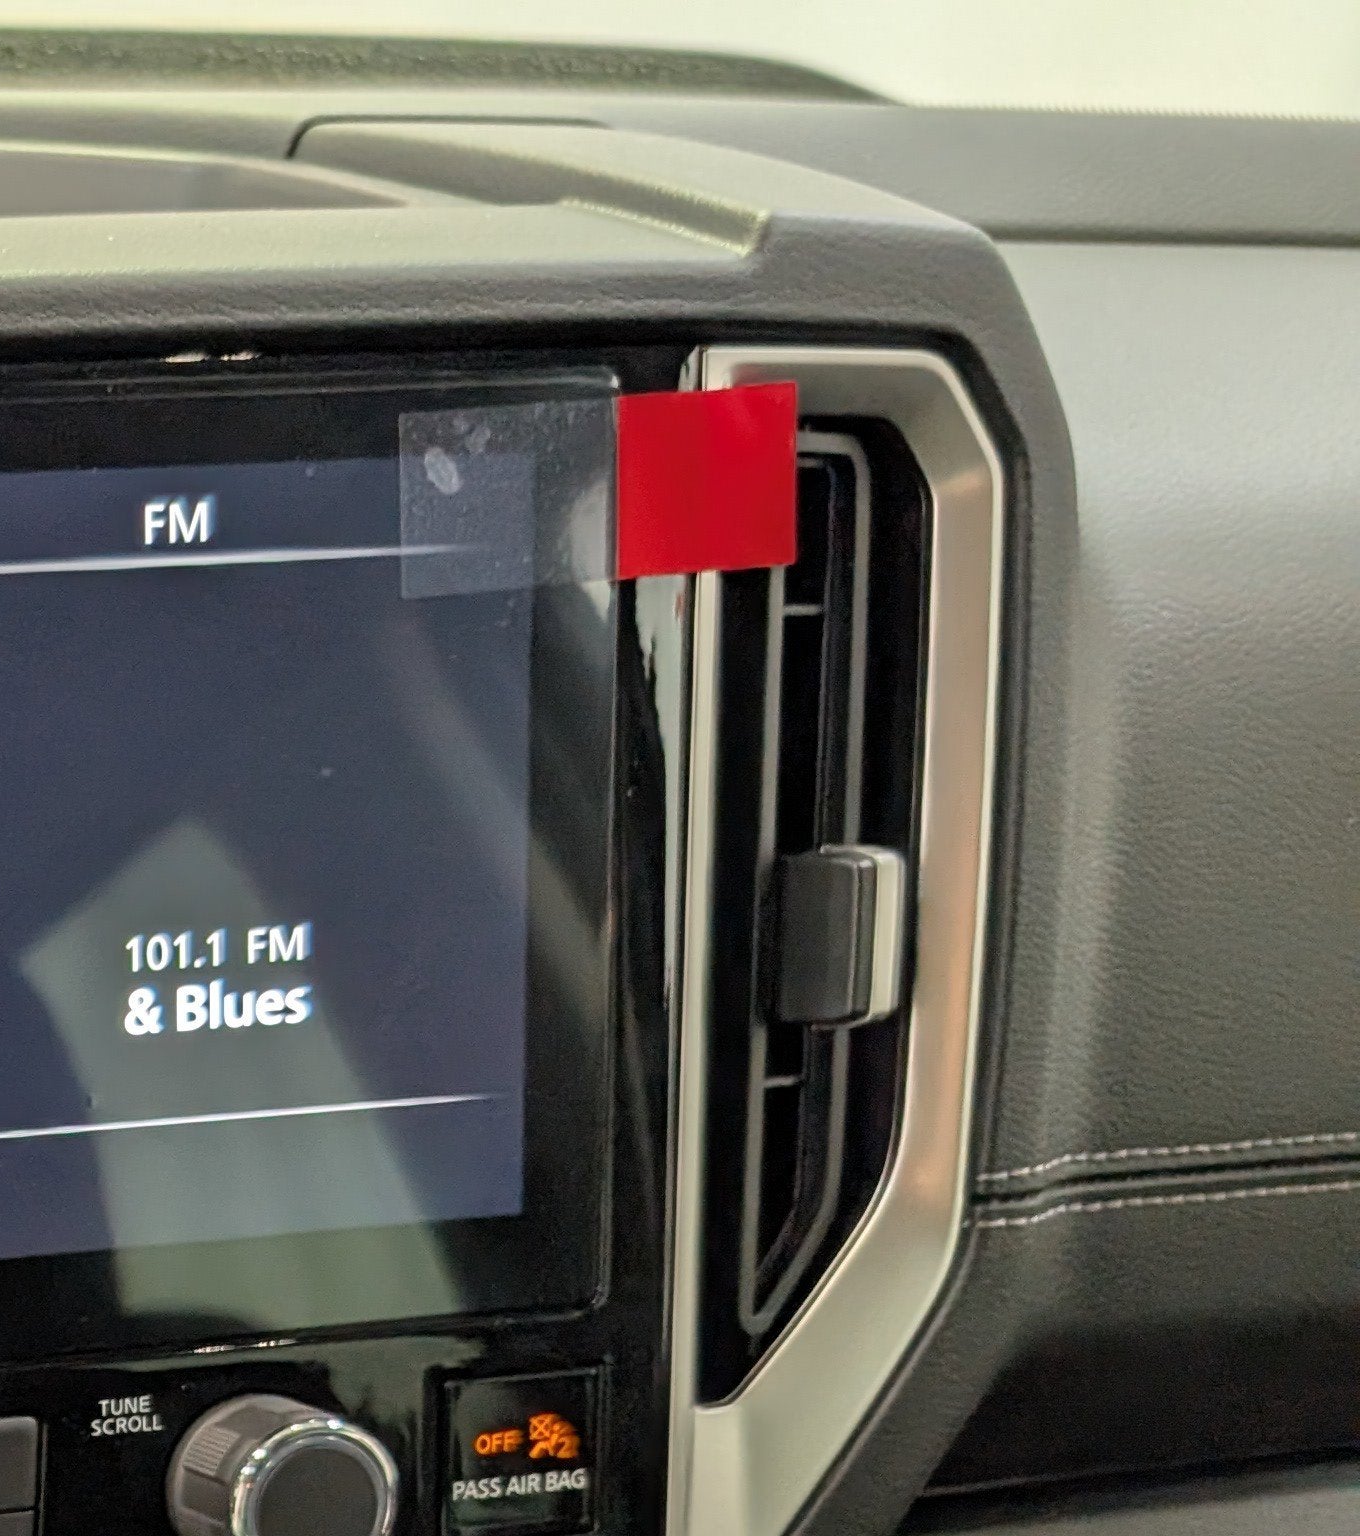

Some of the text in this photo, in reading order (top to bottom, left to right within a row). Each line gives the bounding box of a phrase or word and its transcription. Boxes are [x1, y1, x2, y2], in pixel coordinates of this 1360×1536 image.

[144, 496, 212, 545] FM
[125, 923, 311, 973] 101.1 FM
[124, 978, 313, 1036] & Blues
[98, 1394, 151, 1417] TUNE
[90, 1414, 163, 1437] SCROLL
[474, 1429, 520, 1455] OFF
[452, 1468, 588, 1501] PASS AIR BAG
